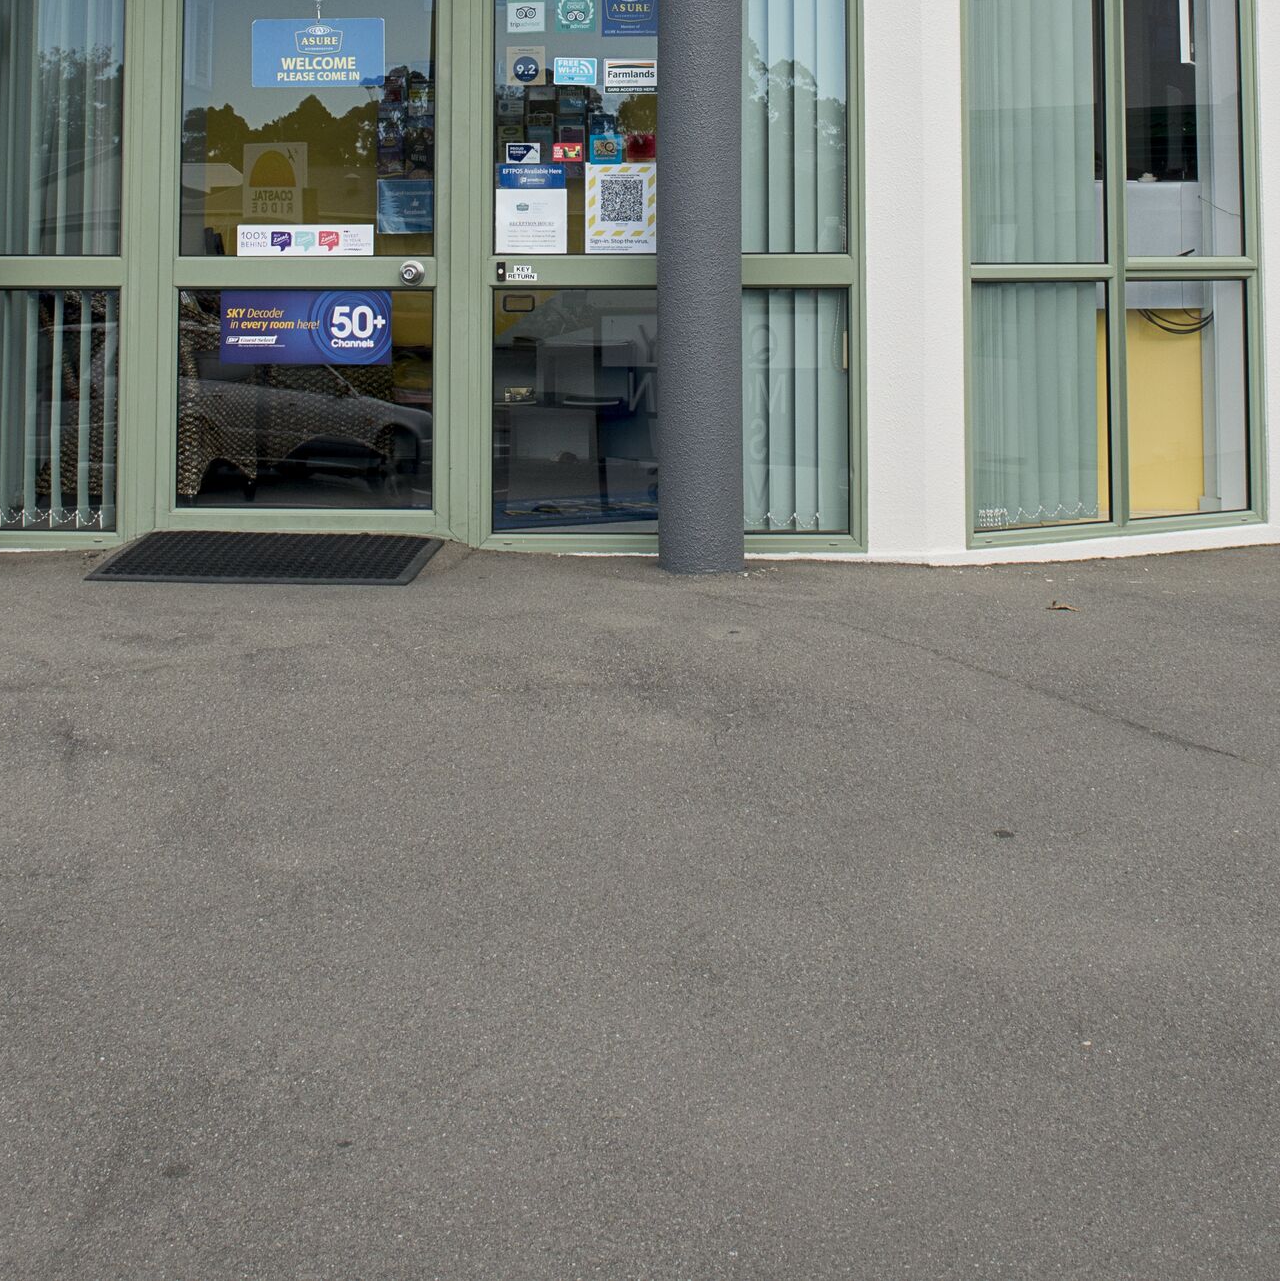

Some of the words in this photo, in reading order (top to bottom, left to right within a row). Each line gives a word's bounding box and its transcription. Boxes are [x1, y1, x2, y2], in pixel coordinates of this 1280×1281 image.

[611, 3, 651, 12] ASURE
[301, 36, 338, 45] ASURE
[281, 57, 356, 70] WELCOME
[516, 64, 536, 75] 9.2
[607, 70, 655, 79] Farmlands
[277, 72, 315, 82] PLEASE
[317, 72, 347, 81] COME
[349, 71, 360, 81] IN
[241, 231, 268, 240] 100%
[273, 234, 290, 244] Local
[321, 234, 337, 244] Local
[226, 308, 246, 318] SKY
[247, 306, 285, 319] Decoder
[230, 319, 239, 329] in
[240, 321, 268, 332] every
[269, 320, 295, 329] room
[296, 319, 320, 330] here!
[331, 305, 386, 339] 50+
[331, 339, 374, 349] Channels
